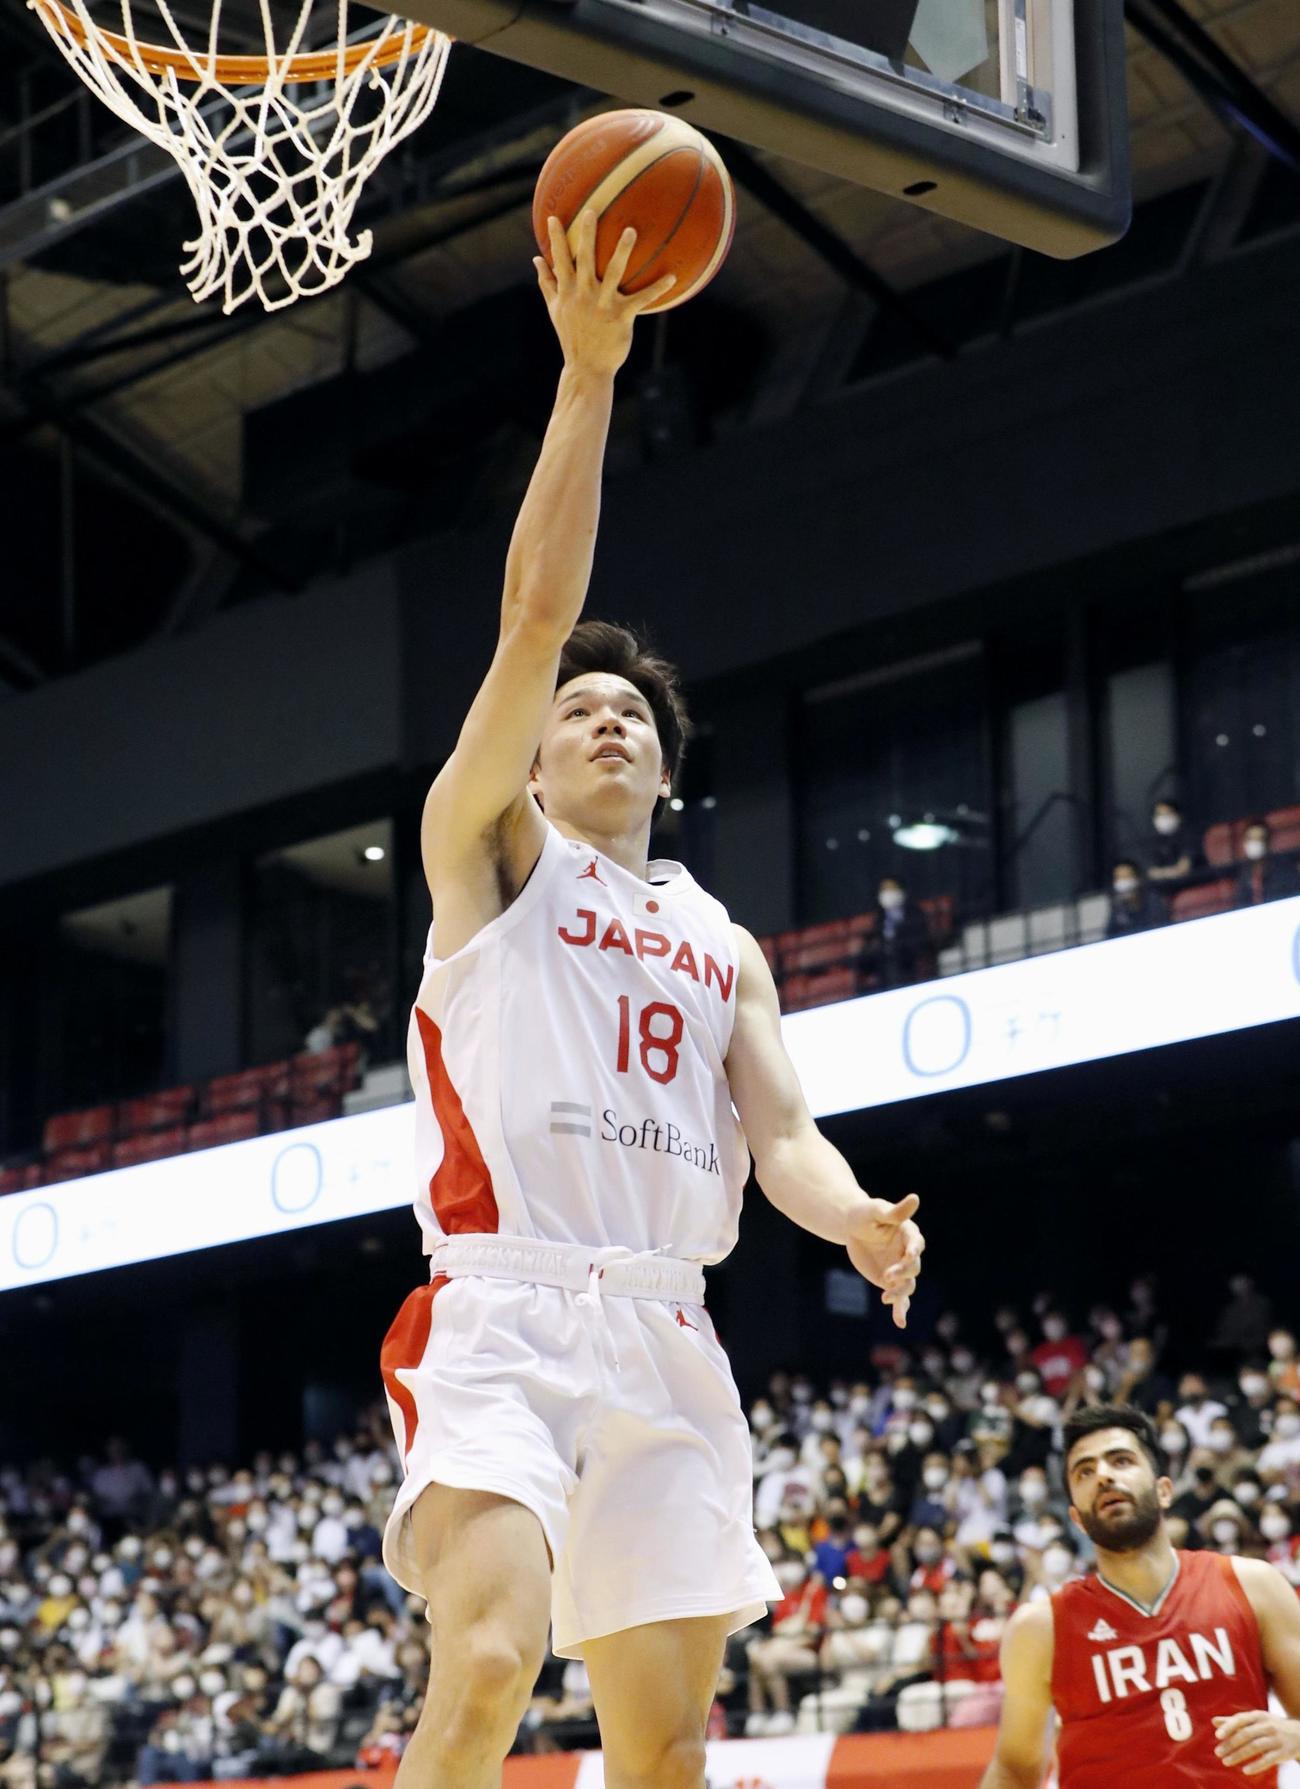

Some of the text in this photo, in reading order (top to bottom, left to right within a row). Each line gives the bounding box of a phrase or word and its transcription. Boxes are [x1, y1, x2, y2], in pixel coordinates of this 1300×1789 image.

[558, 908, 734, 1003] JAPAN
[617, 995, 684, 1085] 18
[601, 1108, 720, 1176] SoftBank
[1091, 1627, 1236, 1704] IRAN
[1160, 1688, 1193, 1742] 8
